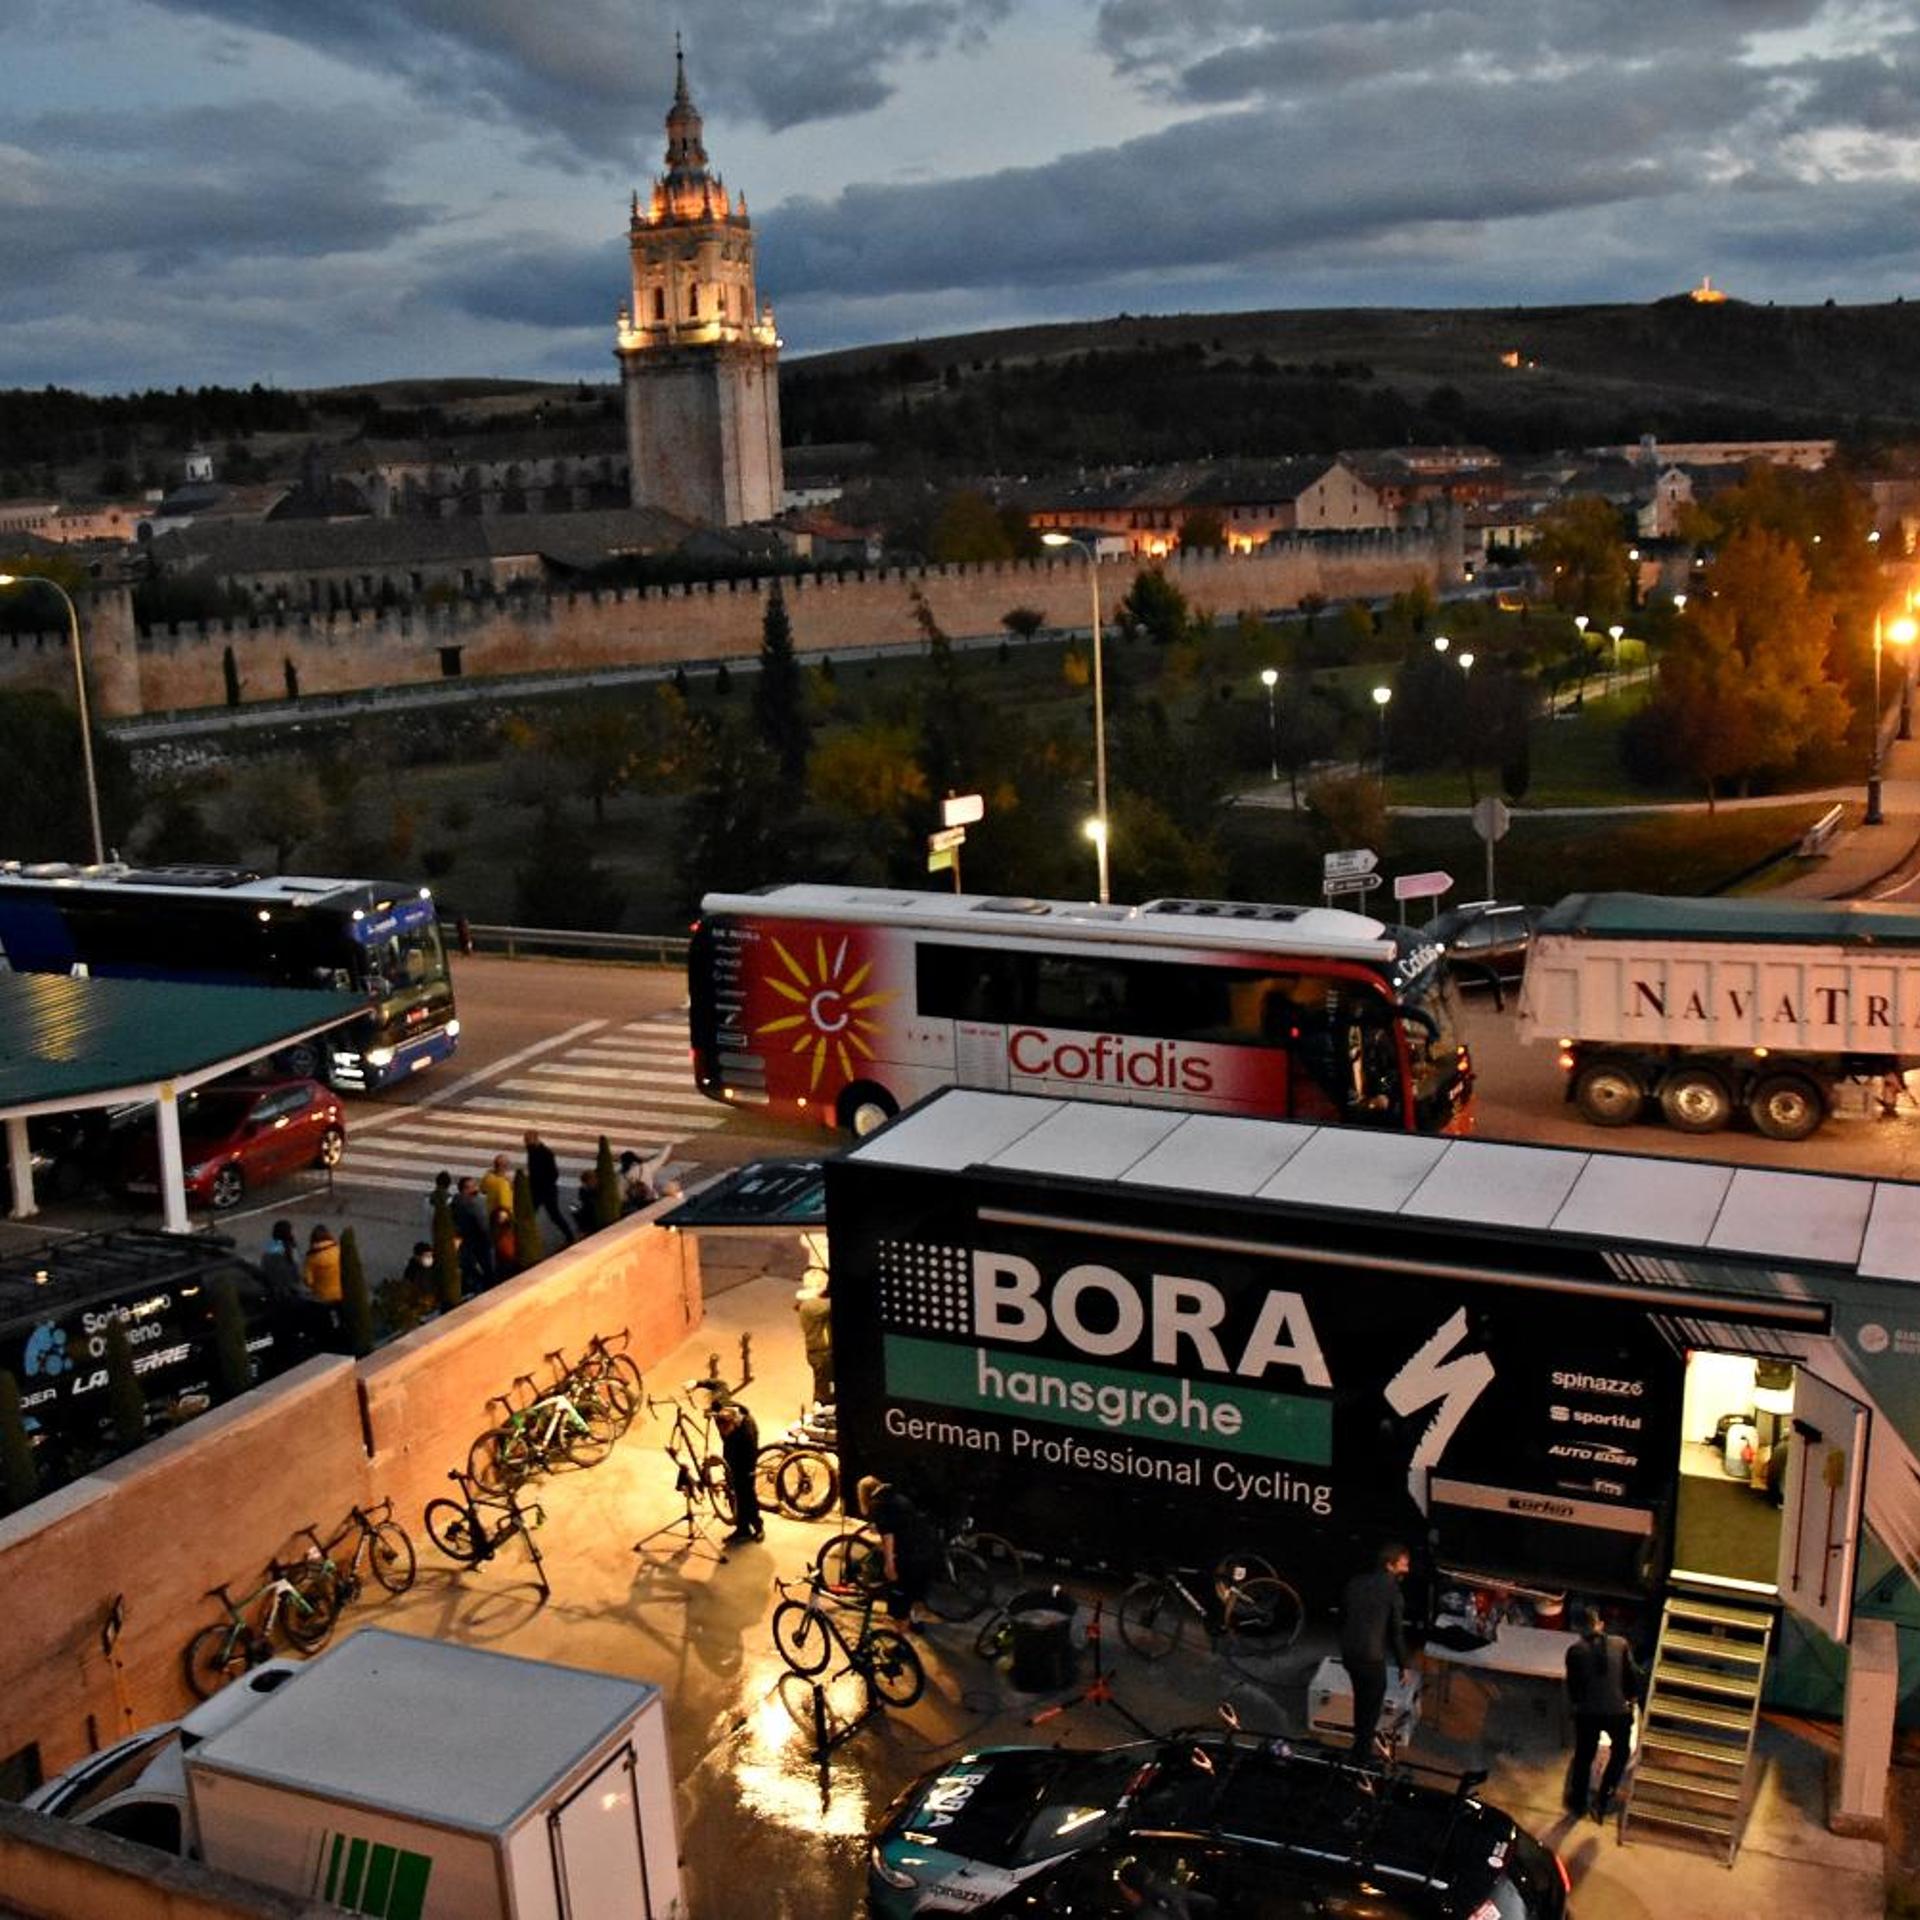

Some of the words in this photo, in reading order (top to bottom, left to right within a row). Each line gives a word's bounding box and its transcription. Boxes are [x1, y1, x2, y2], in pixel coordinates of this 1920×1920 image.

[1008, 1028, 1214, 1092] Cofidis
[972, 1250, 1333, 1388] BORA
[976, 1346, 1242, 1435] hansgrohe
[1573, 1409, 1641, 1430] sportful
[884, 1408, 1001, 1452] German
[1012, 1428, 1201, 1487] Professional
[1212, 1462, 1333, 1515] Cycling
[1548, 1444, 1592, 1460] AUTO
[1593, 1450, 1639, 1467] EDER
